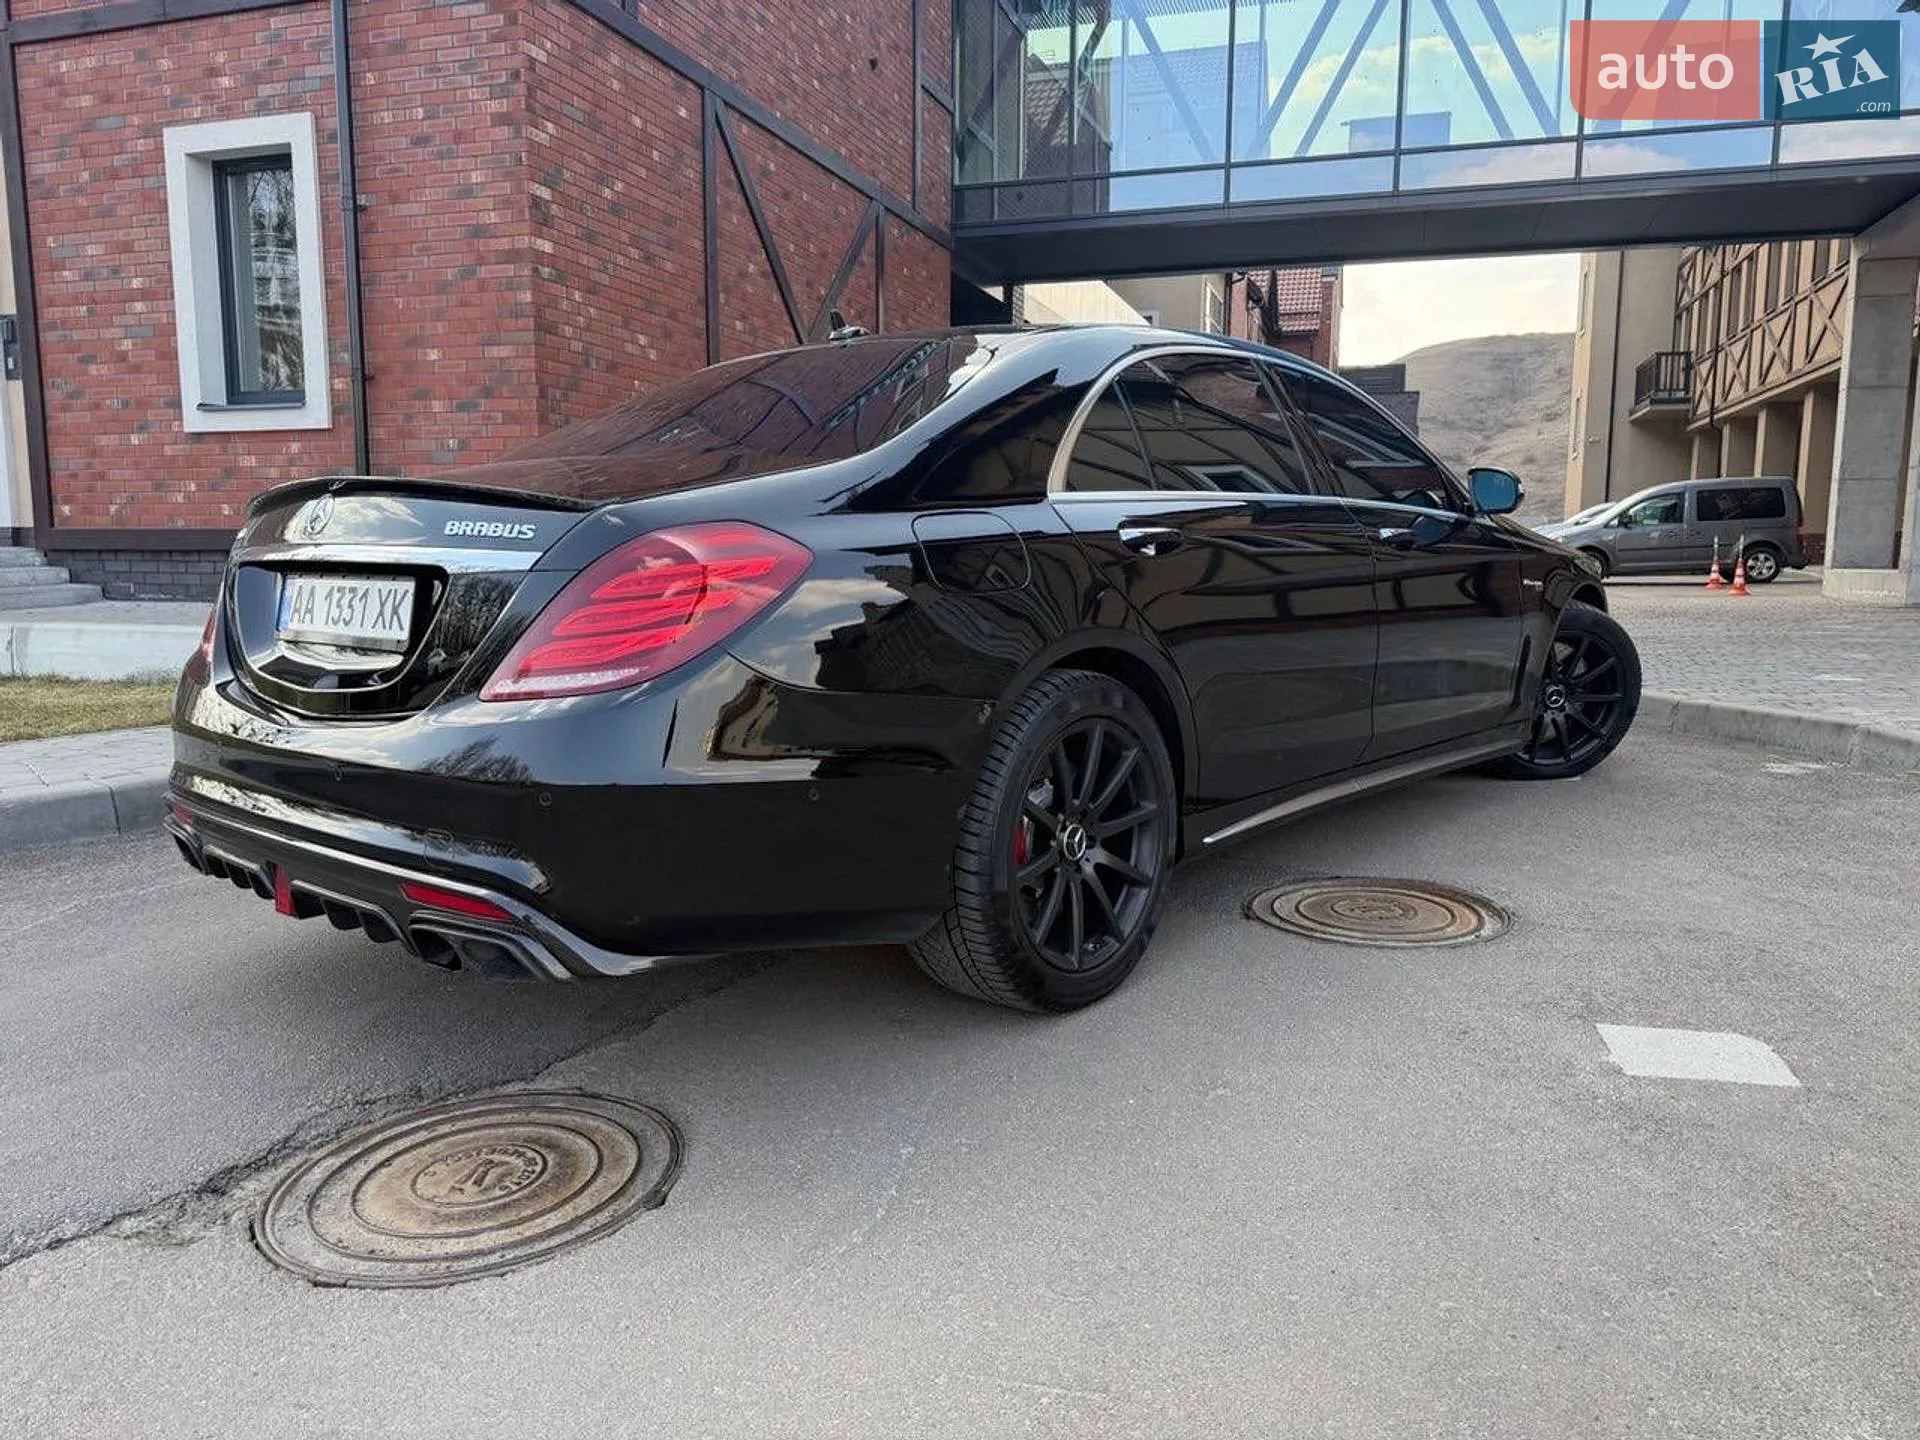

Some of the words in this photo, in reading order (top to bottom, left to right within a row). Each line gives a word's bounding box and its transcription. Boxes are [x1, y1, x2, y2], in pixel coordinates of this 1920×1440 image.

[444, 520, 536, 539] BRABUS
[290, 585, 316, 624] AA
[324, 586, 370, 628] 1331
[371, 588, 409, 631] XK
